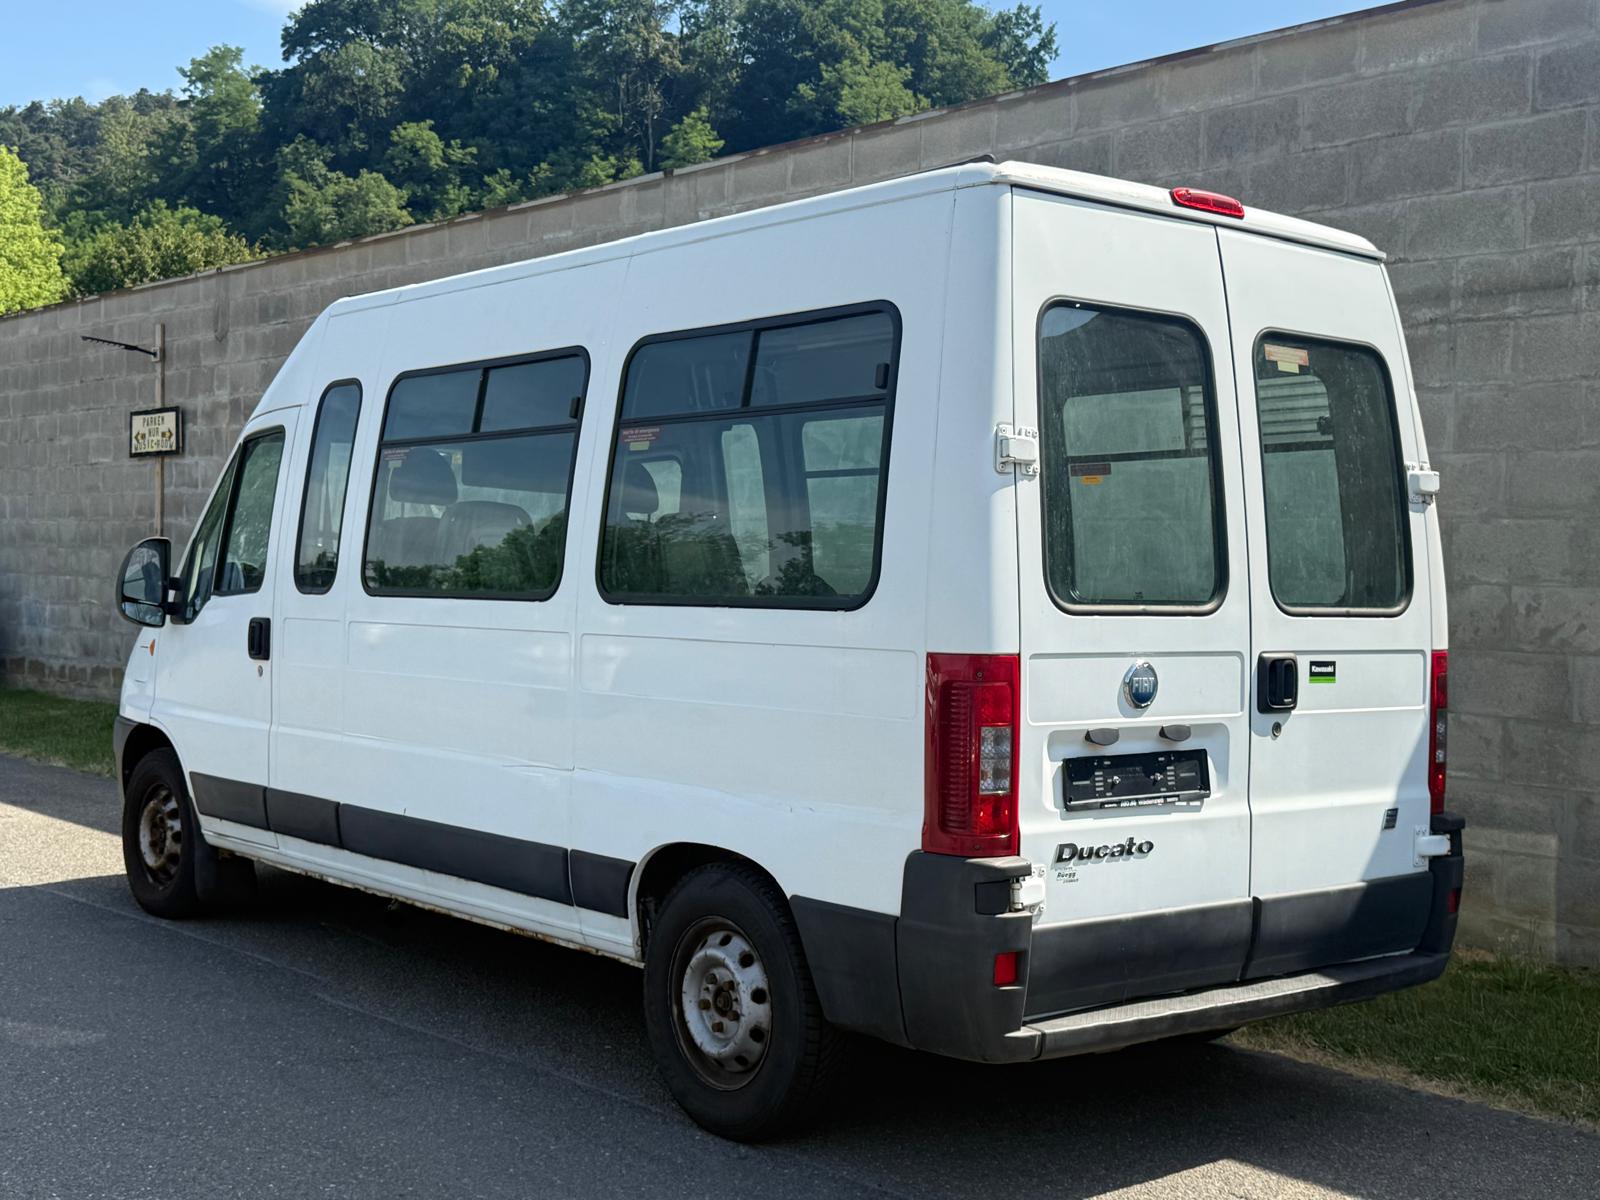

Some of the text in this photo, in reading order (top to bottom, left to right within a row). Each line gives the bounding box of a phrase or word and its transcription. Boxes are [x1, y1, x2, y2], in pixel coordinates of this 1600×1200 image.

[142, 415, 165, 428] PARKEN
[148, 426, 160, 438] NUR
[1132, 677, 1155, 693] FIAT
[1056, 837, 1154, 864] Ducato
